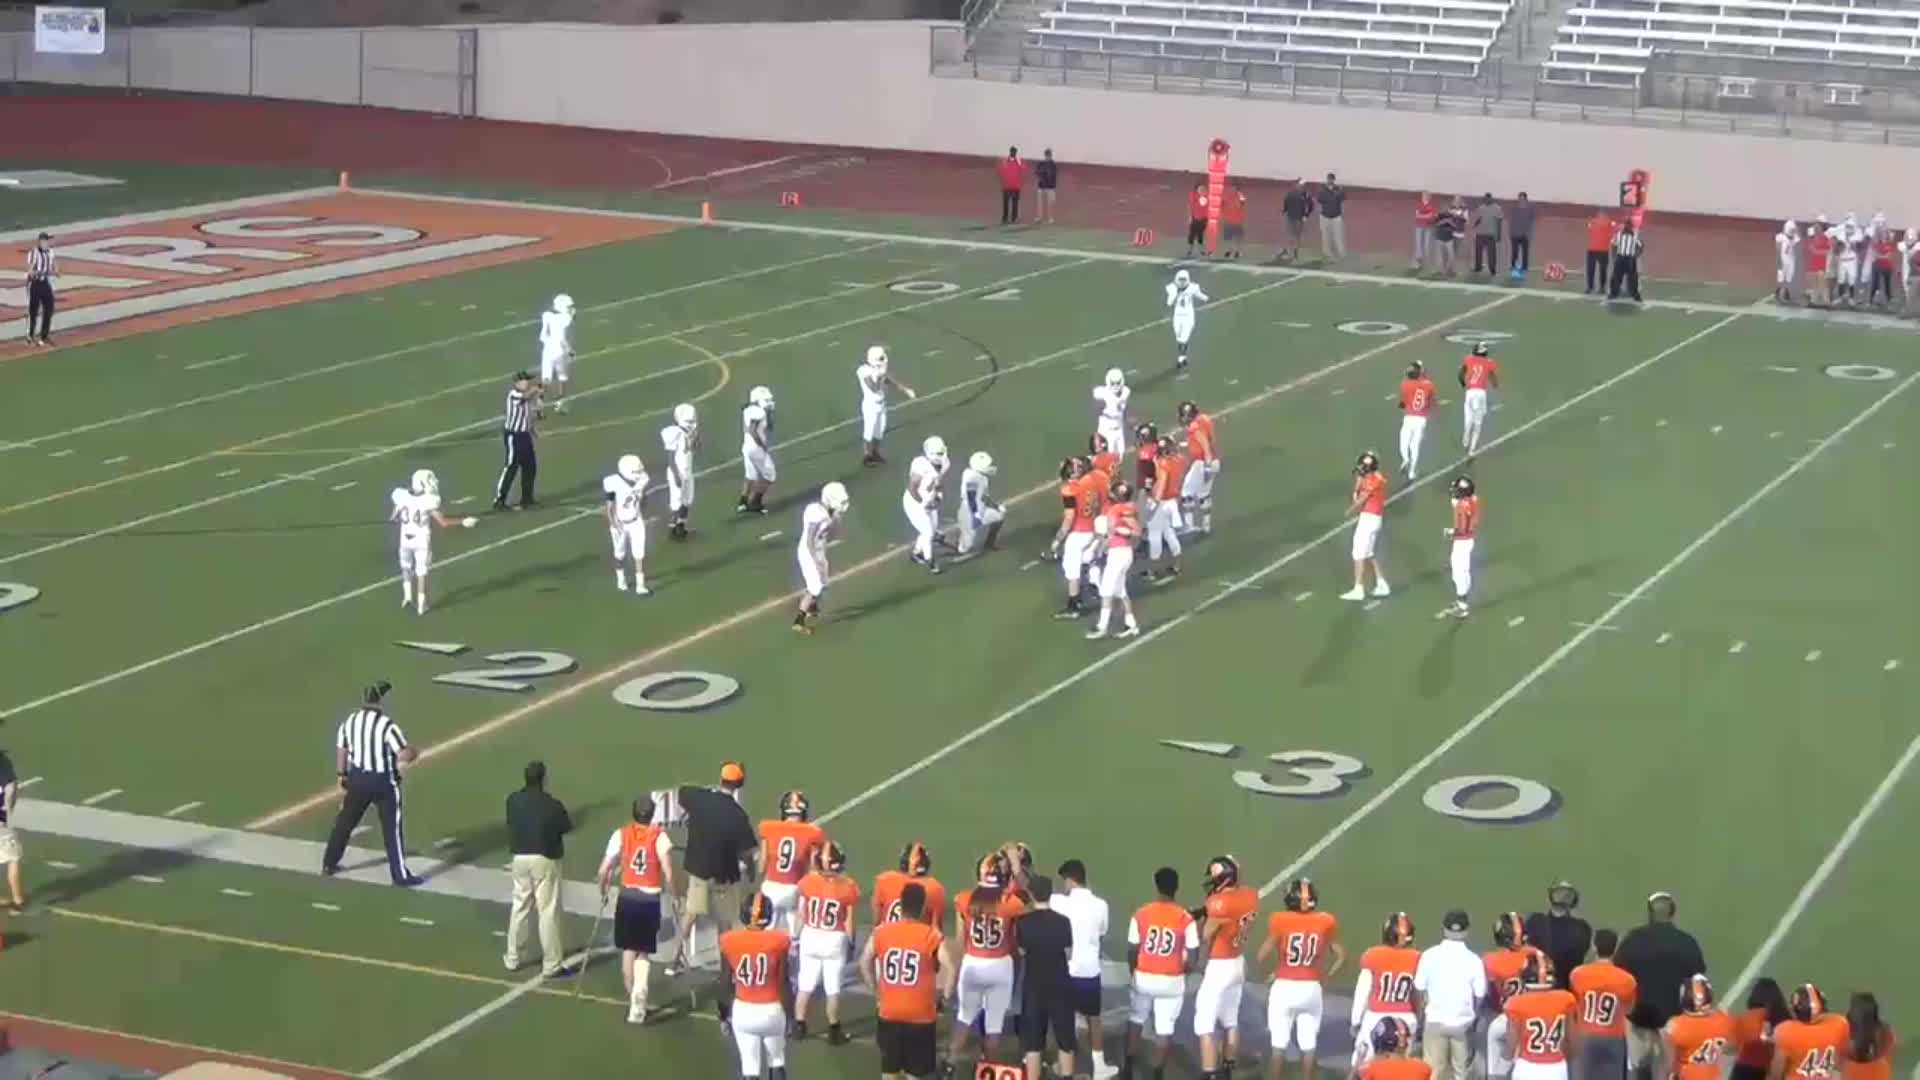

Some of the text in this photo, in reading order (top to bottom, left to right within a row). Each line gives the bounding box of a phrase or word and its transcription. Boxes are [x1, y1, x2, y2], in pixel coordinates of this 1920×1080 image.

[629, 845, 648, 875] 4
[776, 836, 796, 872] 9
[1145, 924, 1177, 957] 33
[1286, 932, 1319, 967] 51
[736, 952, 769, 986] 41
[883, 949, 921, 986] 65
[1583, 991, 1617, 1026] 19
[1527, 1015, 1566, 1054] 24
